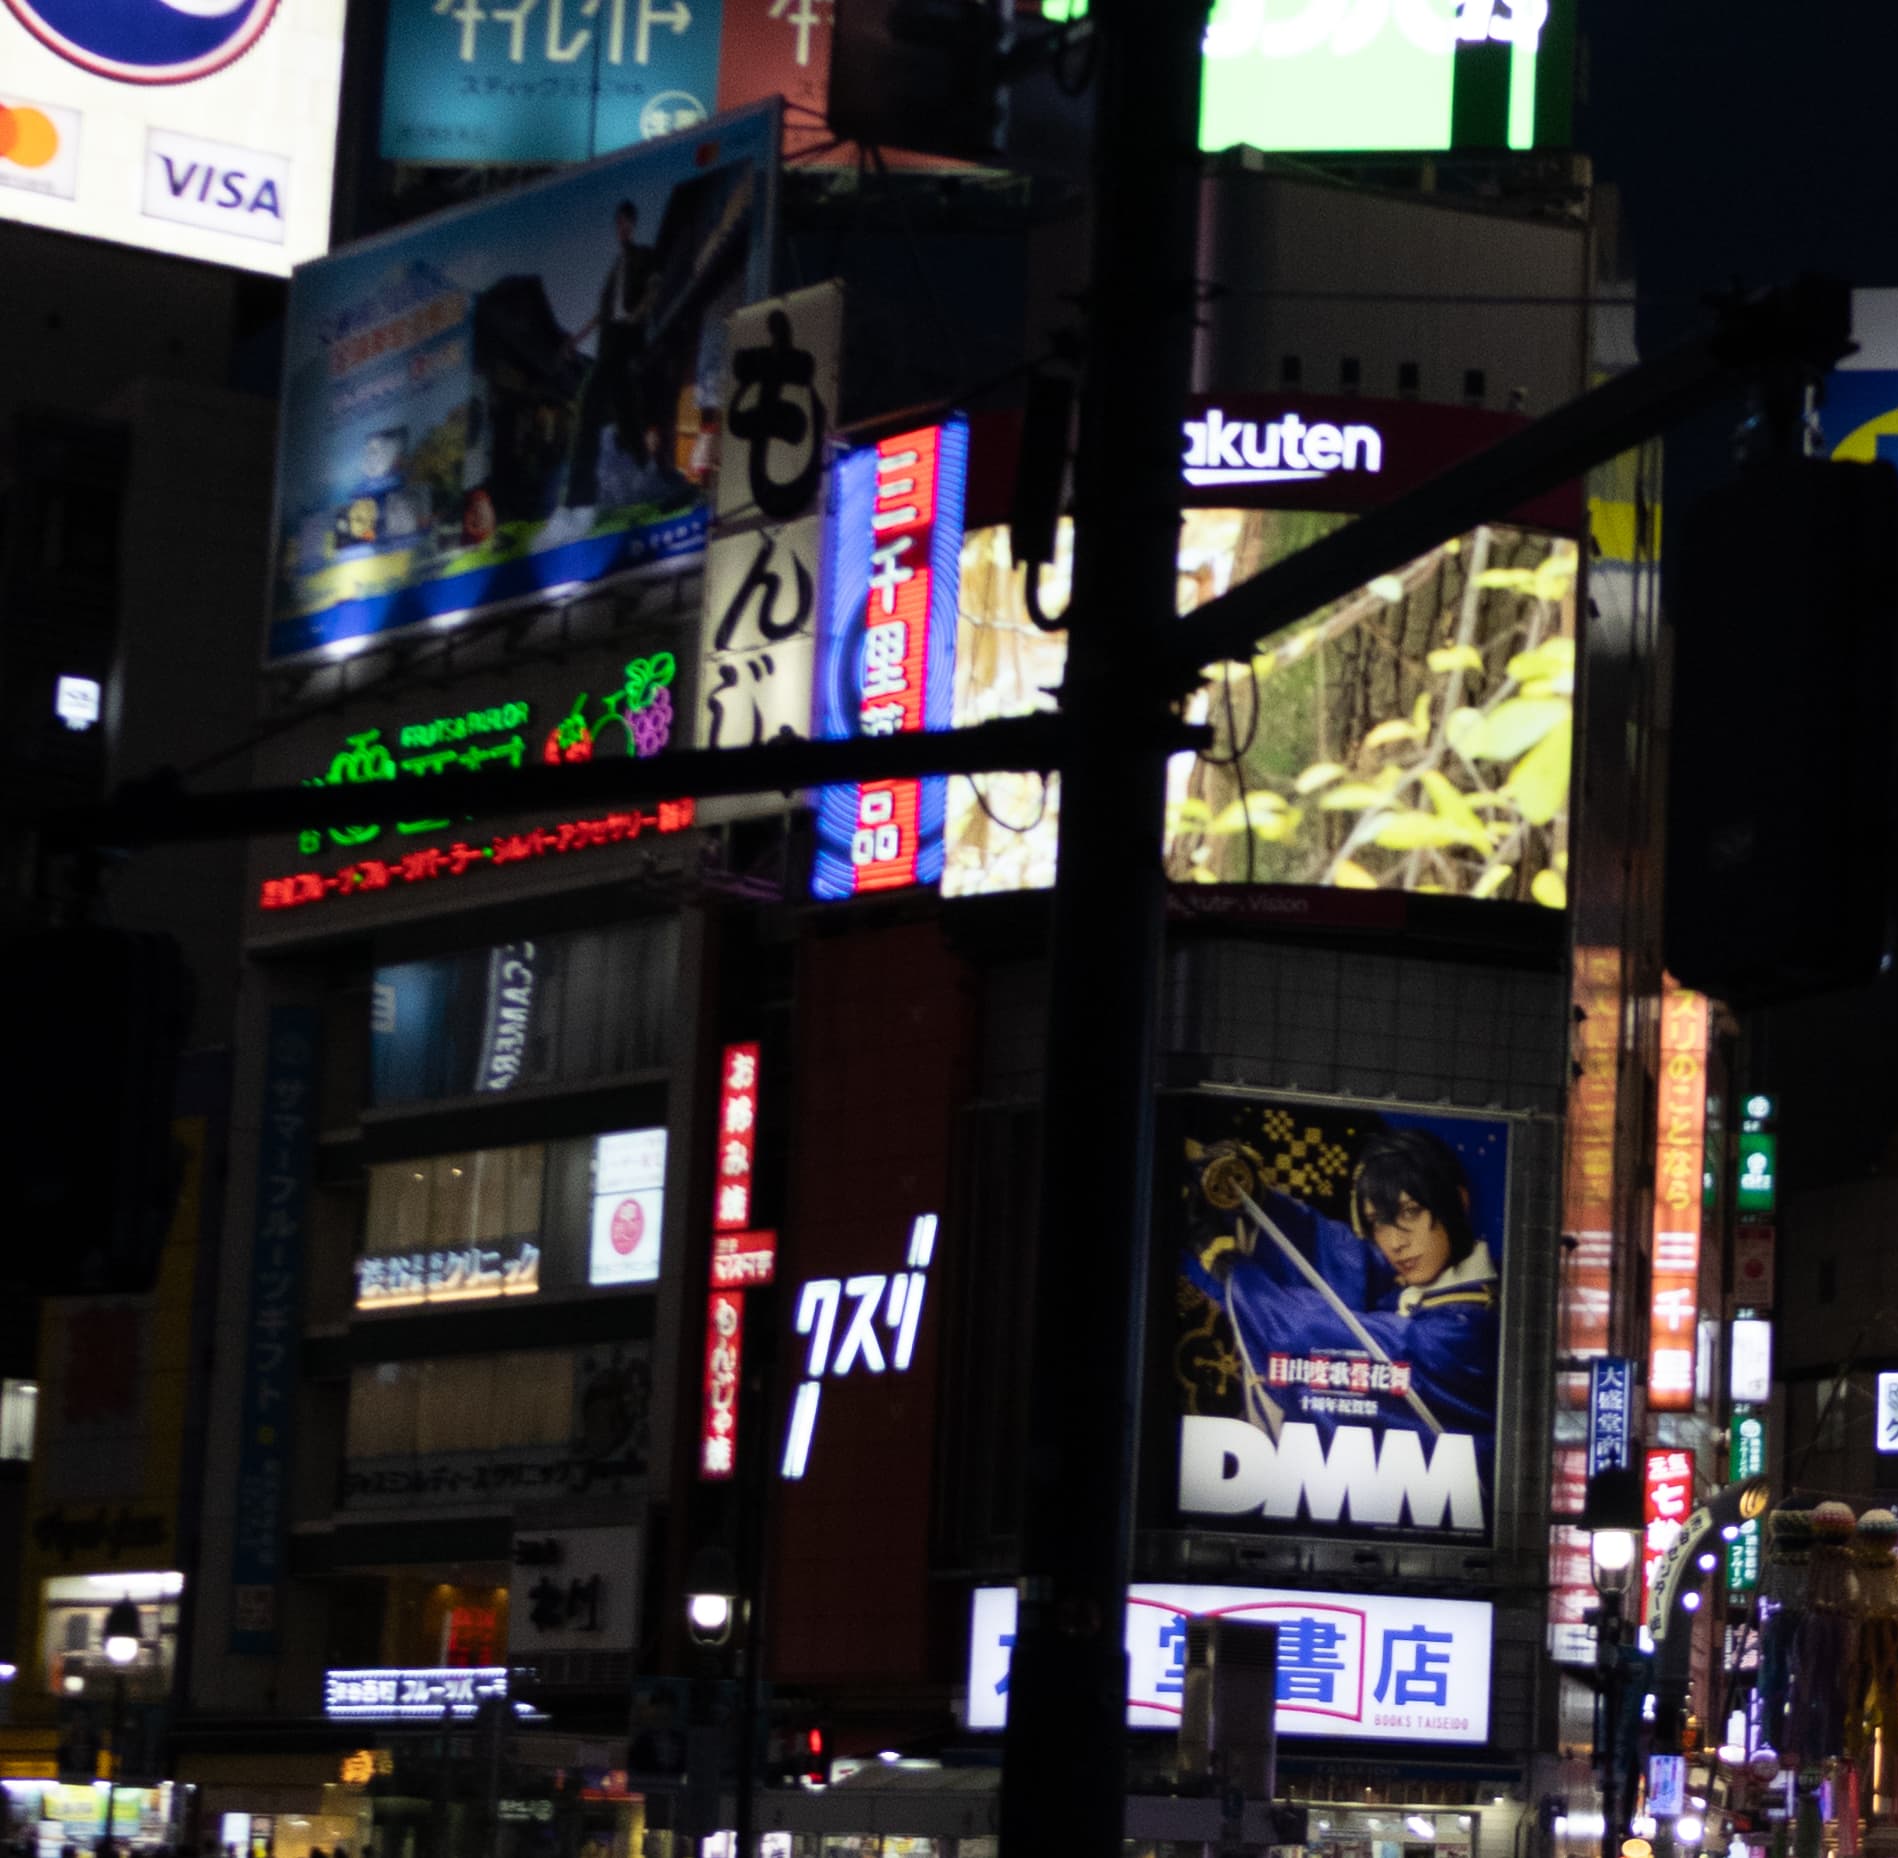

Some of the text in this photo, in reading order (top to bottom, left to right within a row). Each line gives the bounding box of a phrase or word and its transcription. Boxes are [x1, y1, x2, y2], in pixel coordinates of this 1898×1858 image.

[155, 155, 283, 219] VISA
[1183, 409, 1382, 473] akuten
[708, 308, 826, 750] もんじ
[1179, 1414, 1485, 1530] DMM
